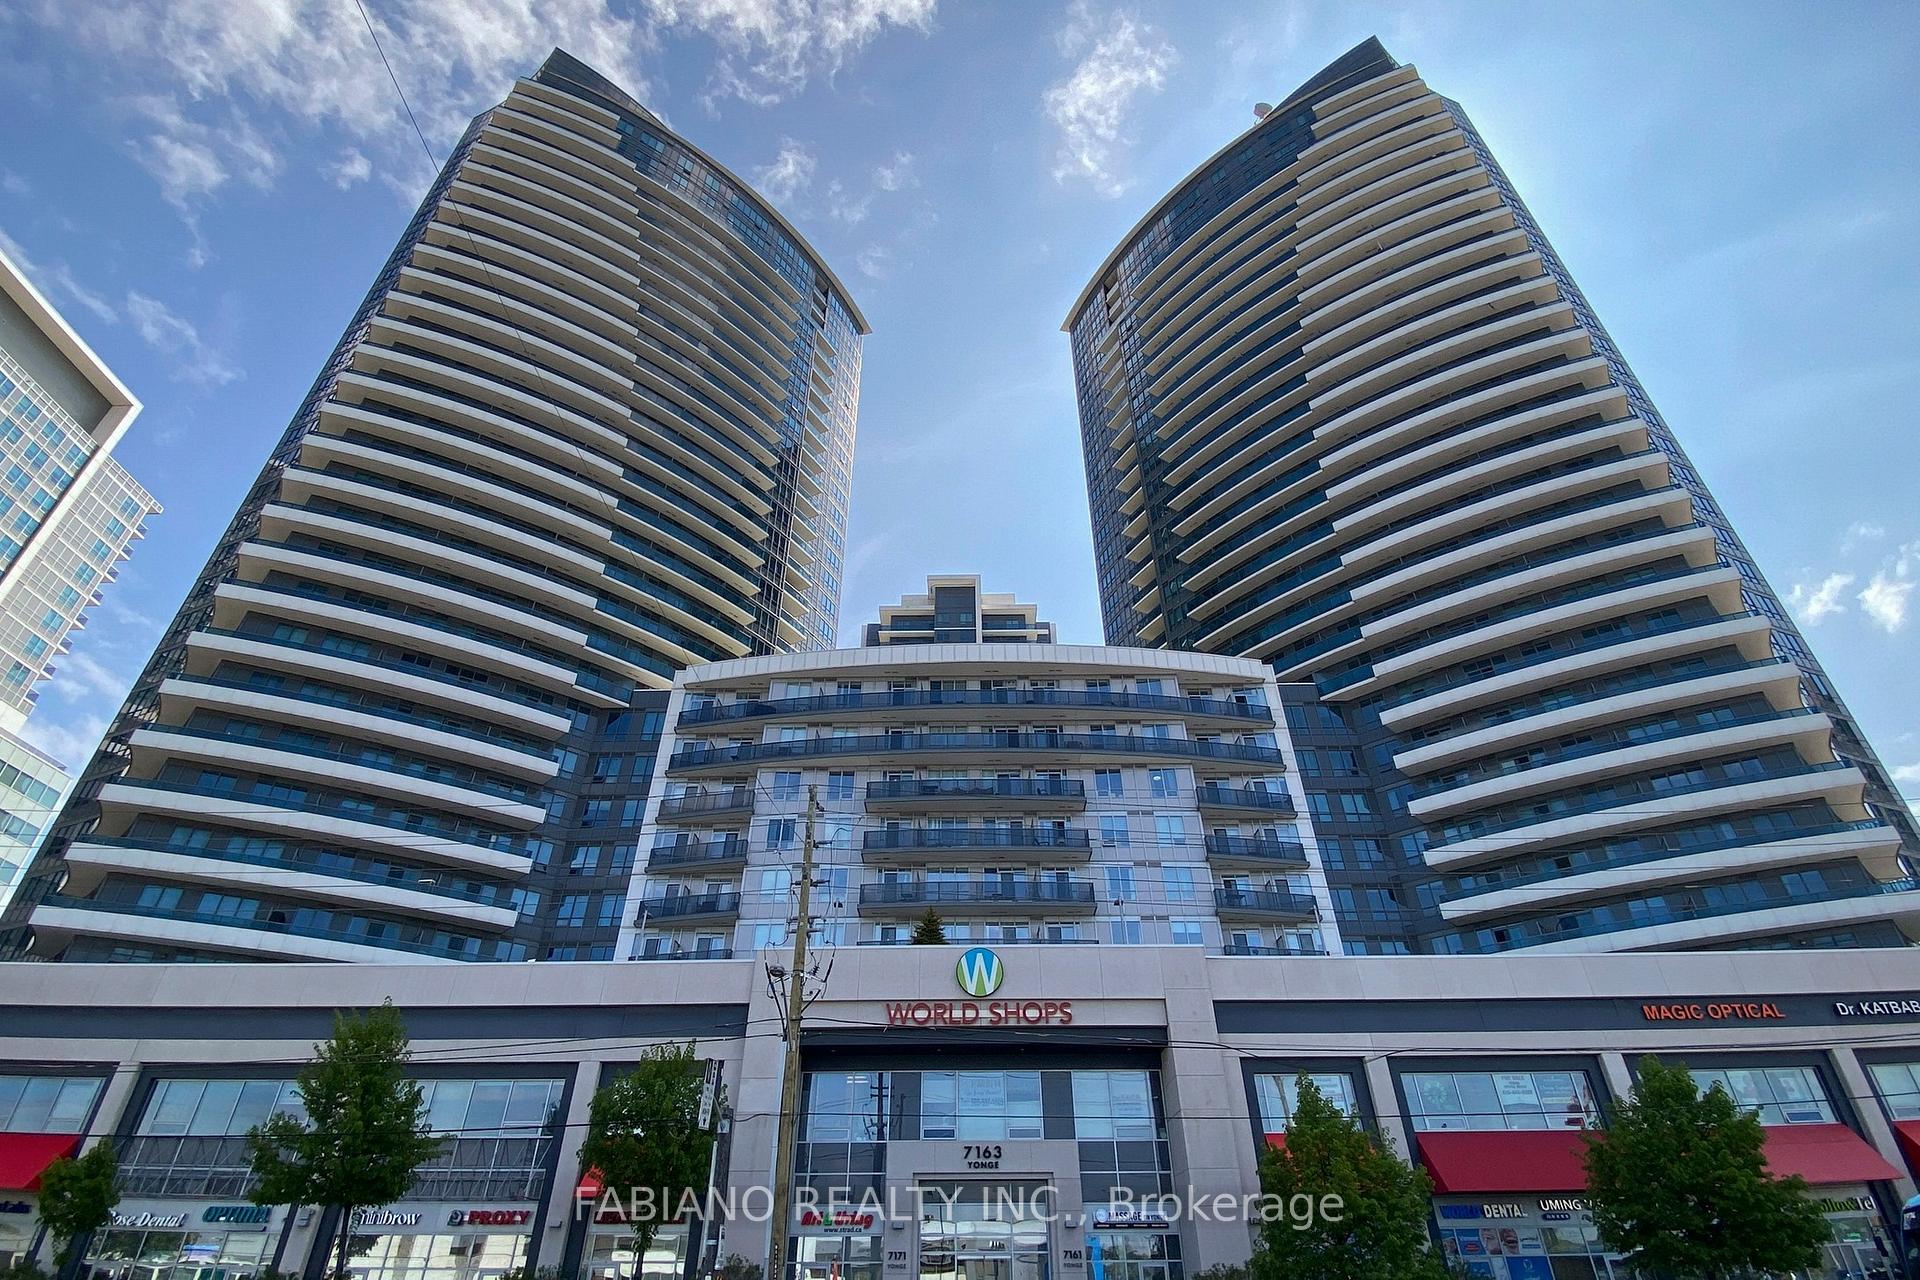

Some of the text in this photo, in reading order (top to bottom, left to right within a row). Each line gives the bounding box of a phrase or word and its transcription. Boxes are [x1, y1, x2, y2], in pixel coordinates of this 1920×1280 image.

[886, 1002, 1072, 1025] WORLD SHOPS
[1642, 1002, 1785, 1020] MAGIC OPTICAL
[1835, 1002, 1860, 1015] Dr.
[963, 1145, 1002, 1160] 7163
[967, 1160, 999, 1169] YONGE
[468, 1210, 531, 1225] PROXY
[1483, 1203, 1529, 1218] DENTAL
[136, 1211, 186, 1227] Dental
[887, 1251, 907, 1261] 7171
[1063, 1250, 1082, 1260] 7161
